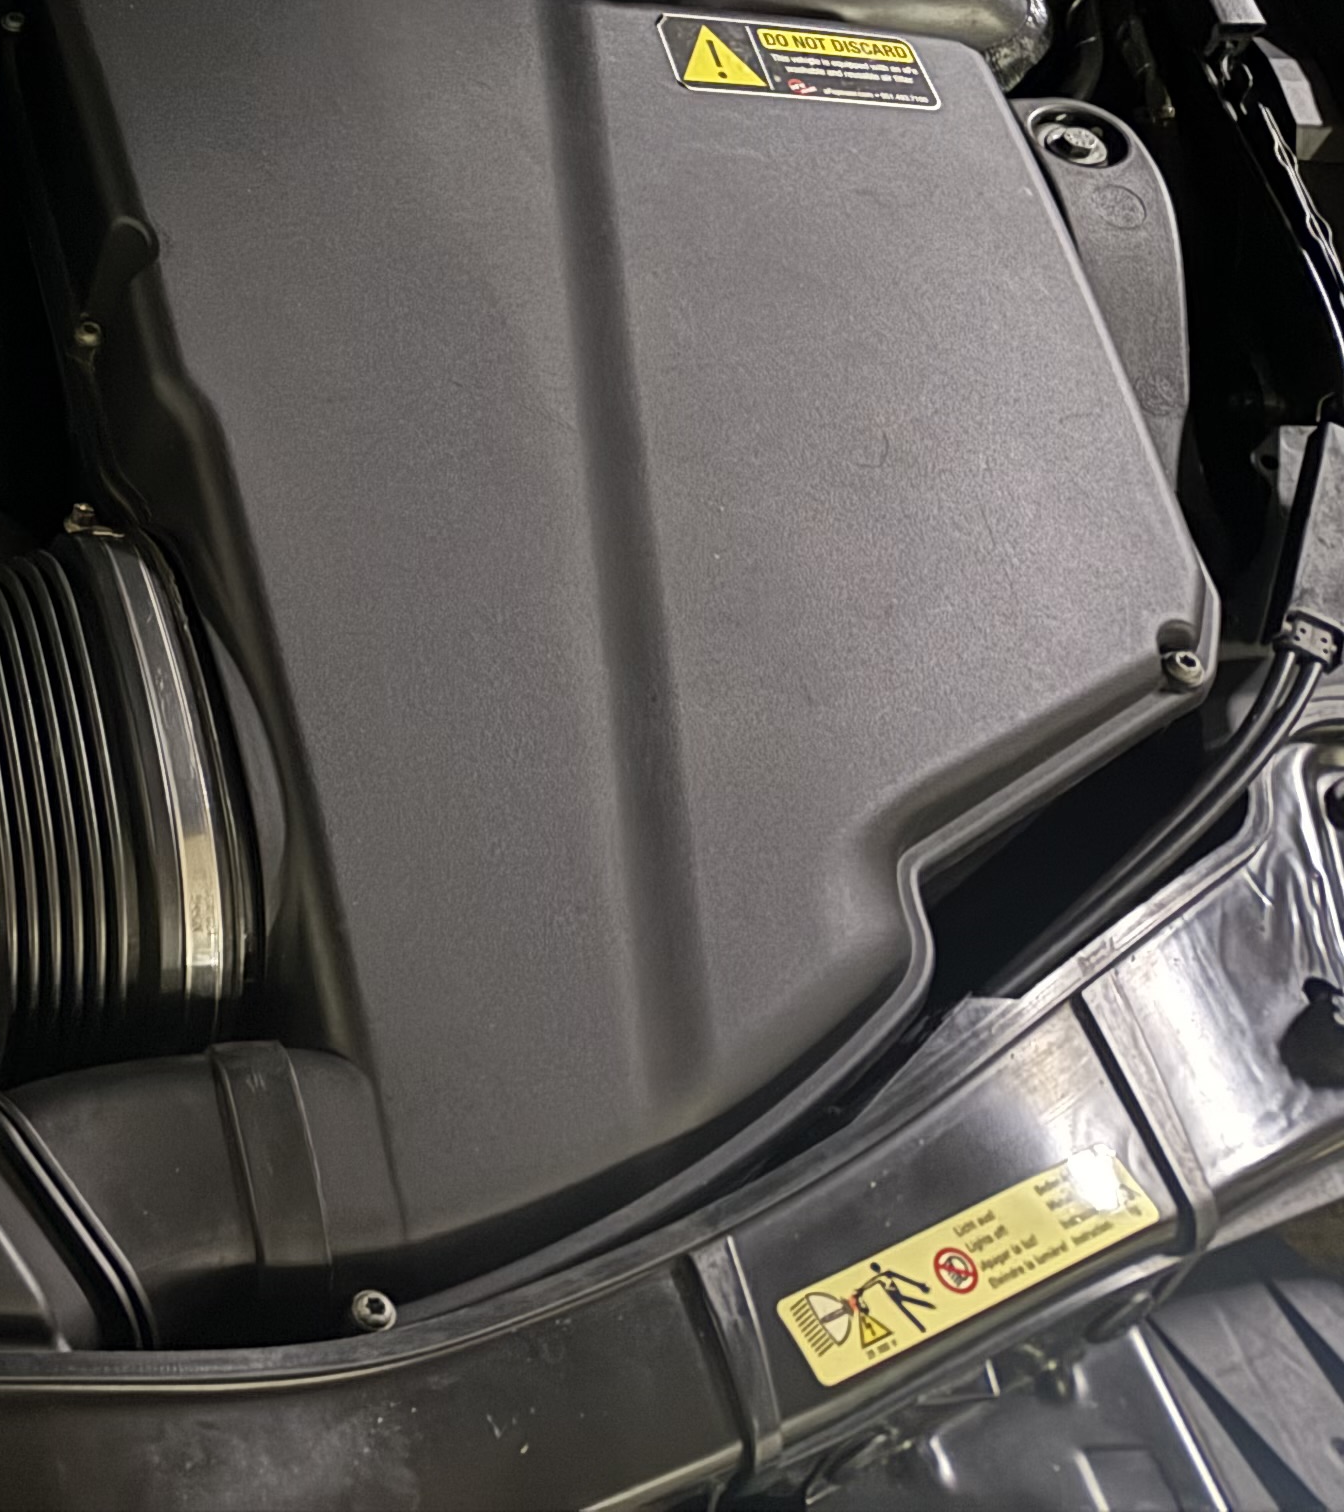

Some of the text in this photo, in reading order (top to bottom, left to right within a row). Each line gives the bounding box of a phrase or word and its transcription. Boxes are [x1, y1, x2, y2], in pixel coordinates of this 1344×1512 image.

[762, 32, 908, 59] DO NOT DISCARD
